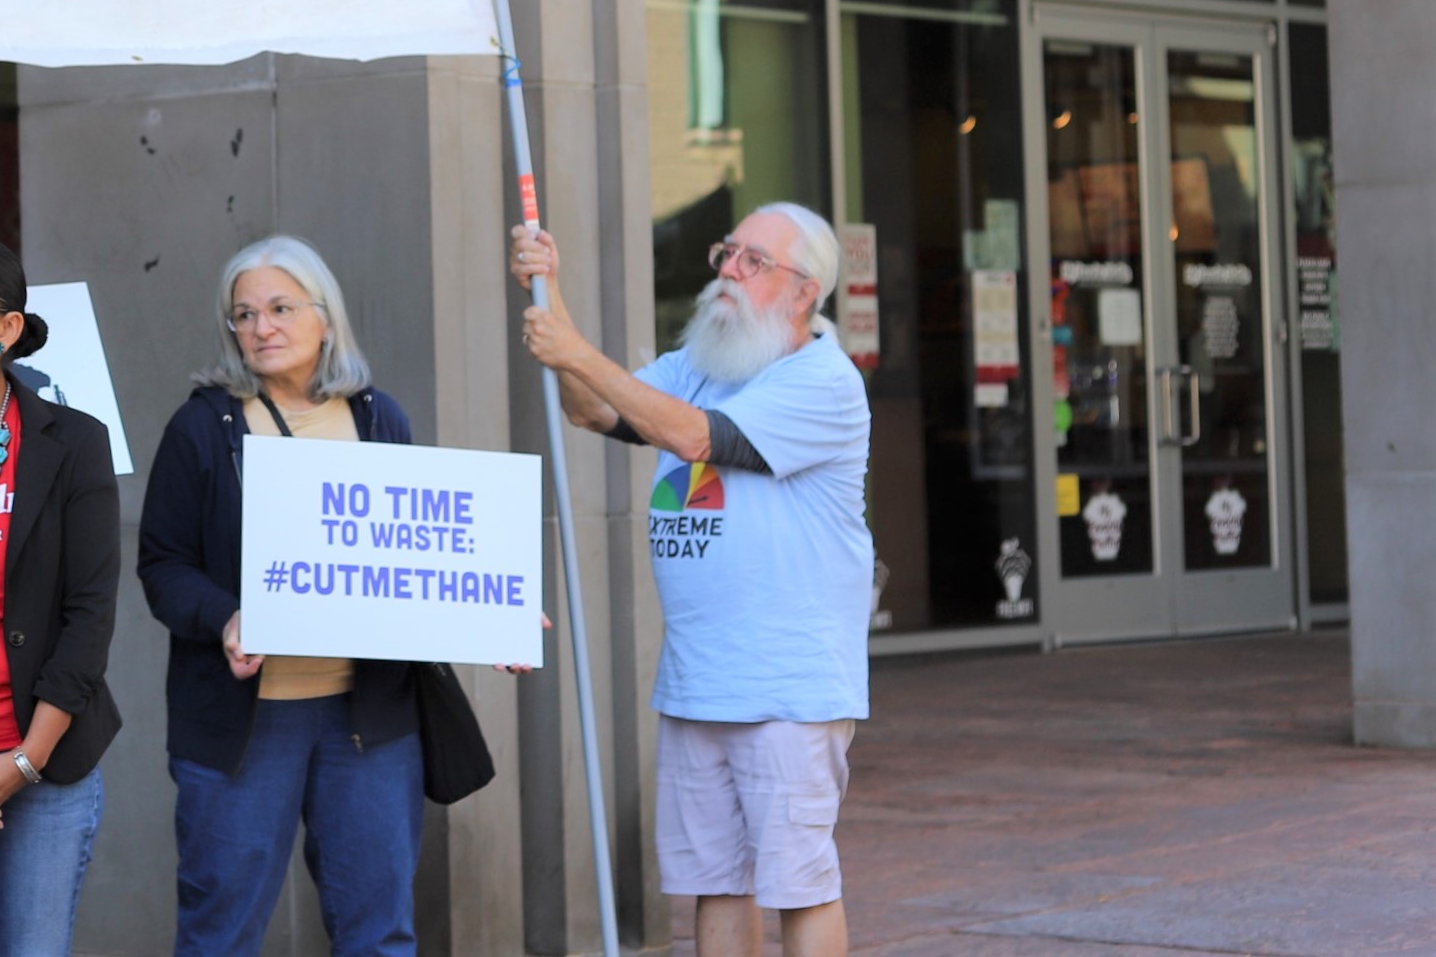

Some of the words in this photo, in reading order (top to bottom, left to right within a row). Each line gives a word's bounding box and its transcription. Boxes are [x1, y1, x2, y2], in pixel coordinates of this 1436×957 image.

[321, 481, 370, 518] NO
[384, 485, 474, 524] TIME
[321, 519, 358, 546] TO
[370, 522, 475, 554] WASTE:
[648, 515, 723, 536] XTREME
[263, 561, 524, 607] #CUTMETHANE
